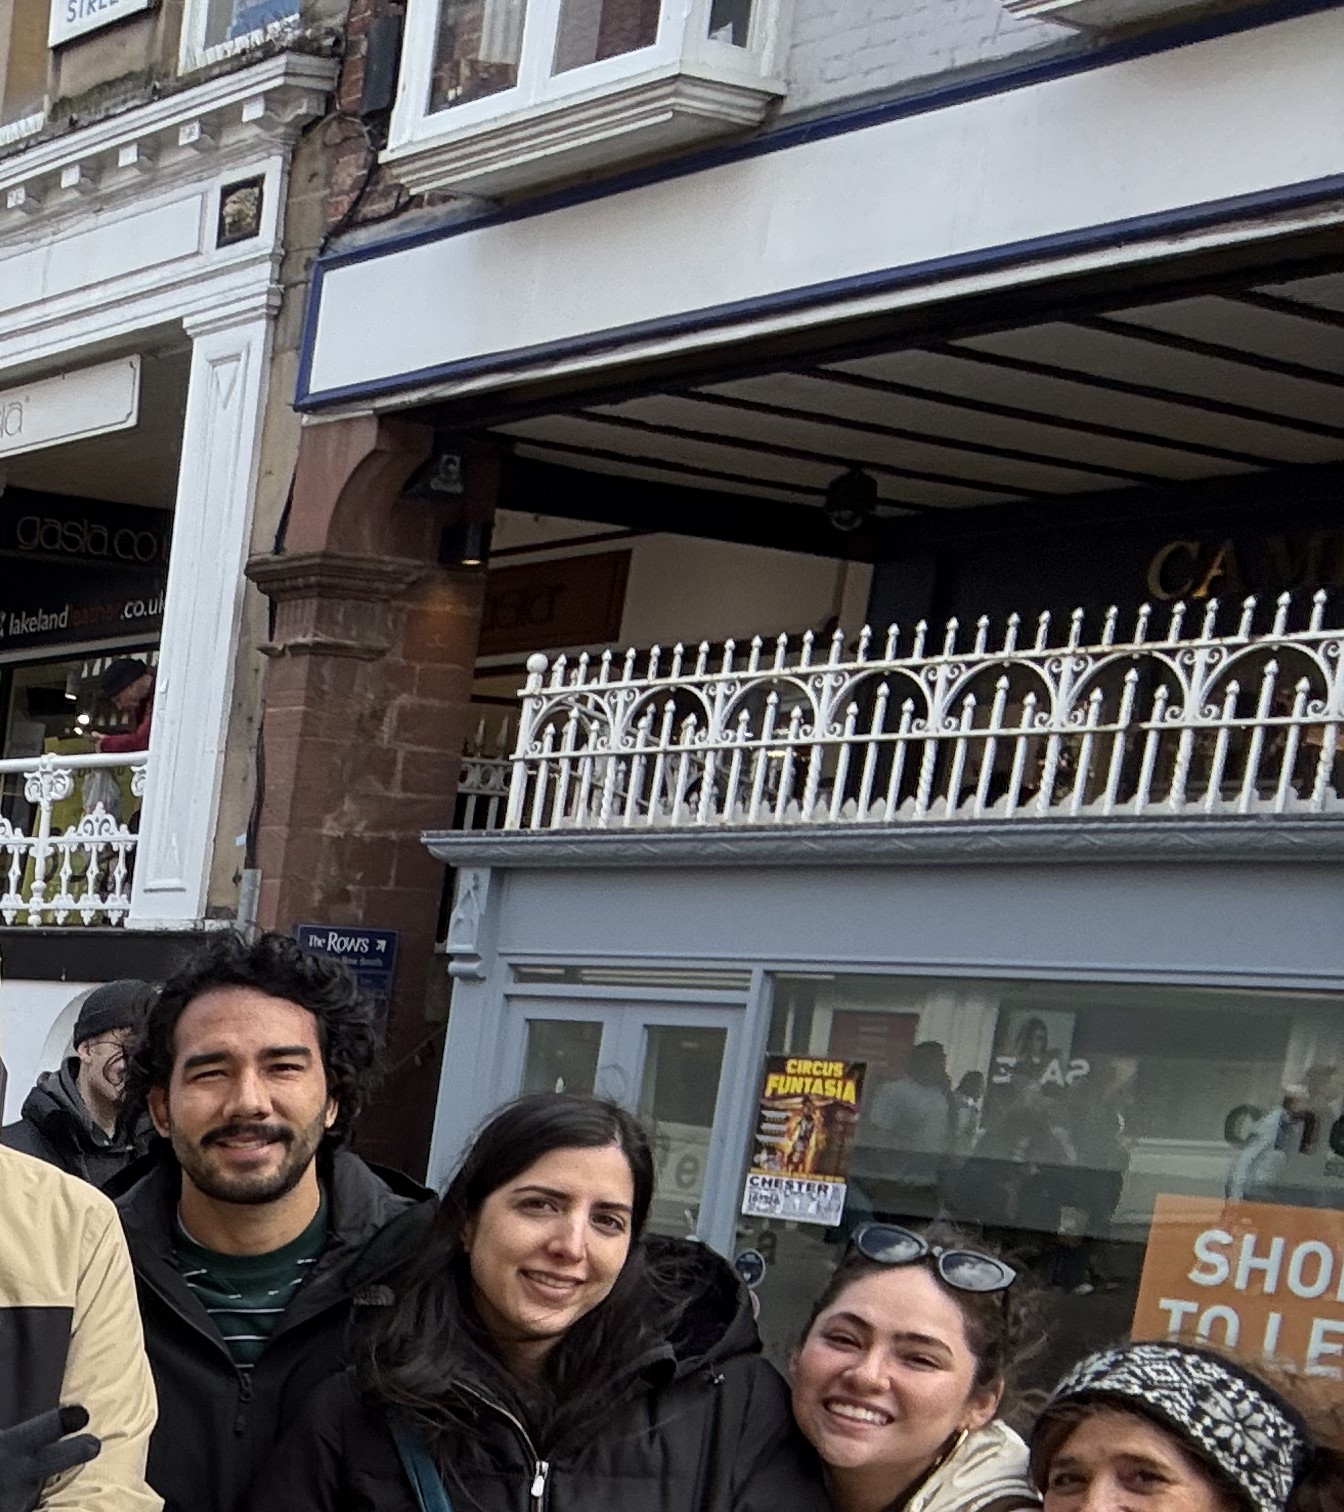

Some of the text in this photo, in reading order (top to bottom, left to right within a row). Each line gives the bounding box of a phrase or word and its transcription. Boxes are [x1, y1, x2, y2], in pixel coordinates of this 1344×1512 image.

[786, 1058, 844, 1077] CIRCUS
[765, 1074, 856, 1104] FUNTASIA
[749, 1176, 830, 1196] CHESTER
[1187, 1229, 1344, 1302] SHO
[1159, 1297, 1240, 1347] TO
